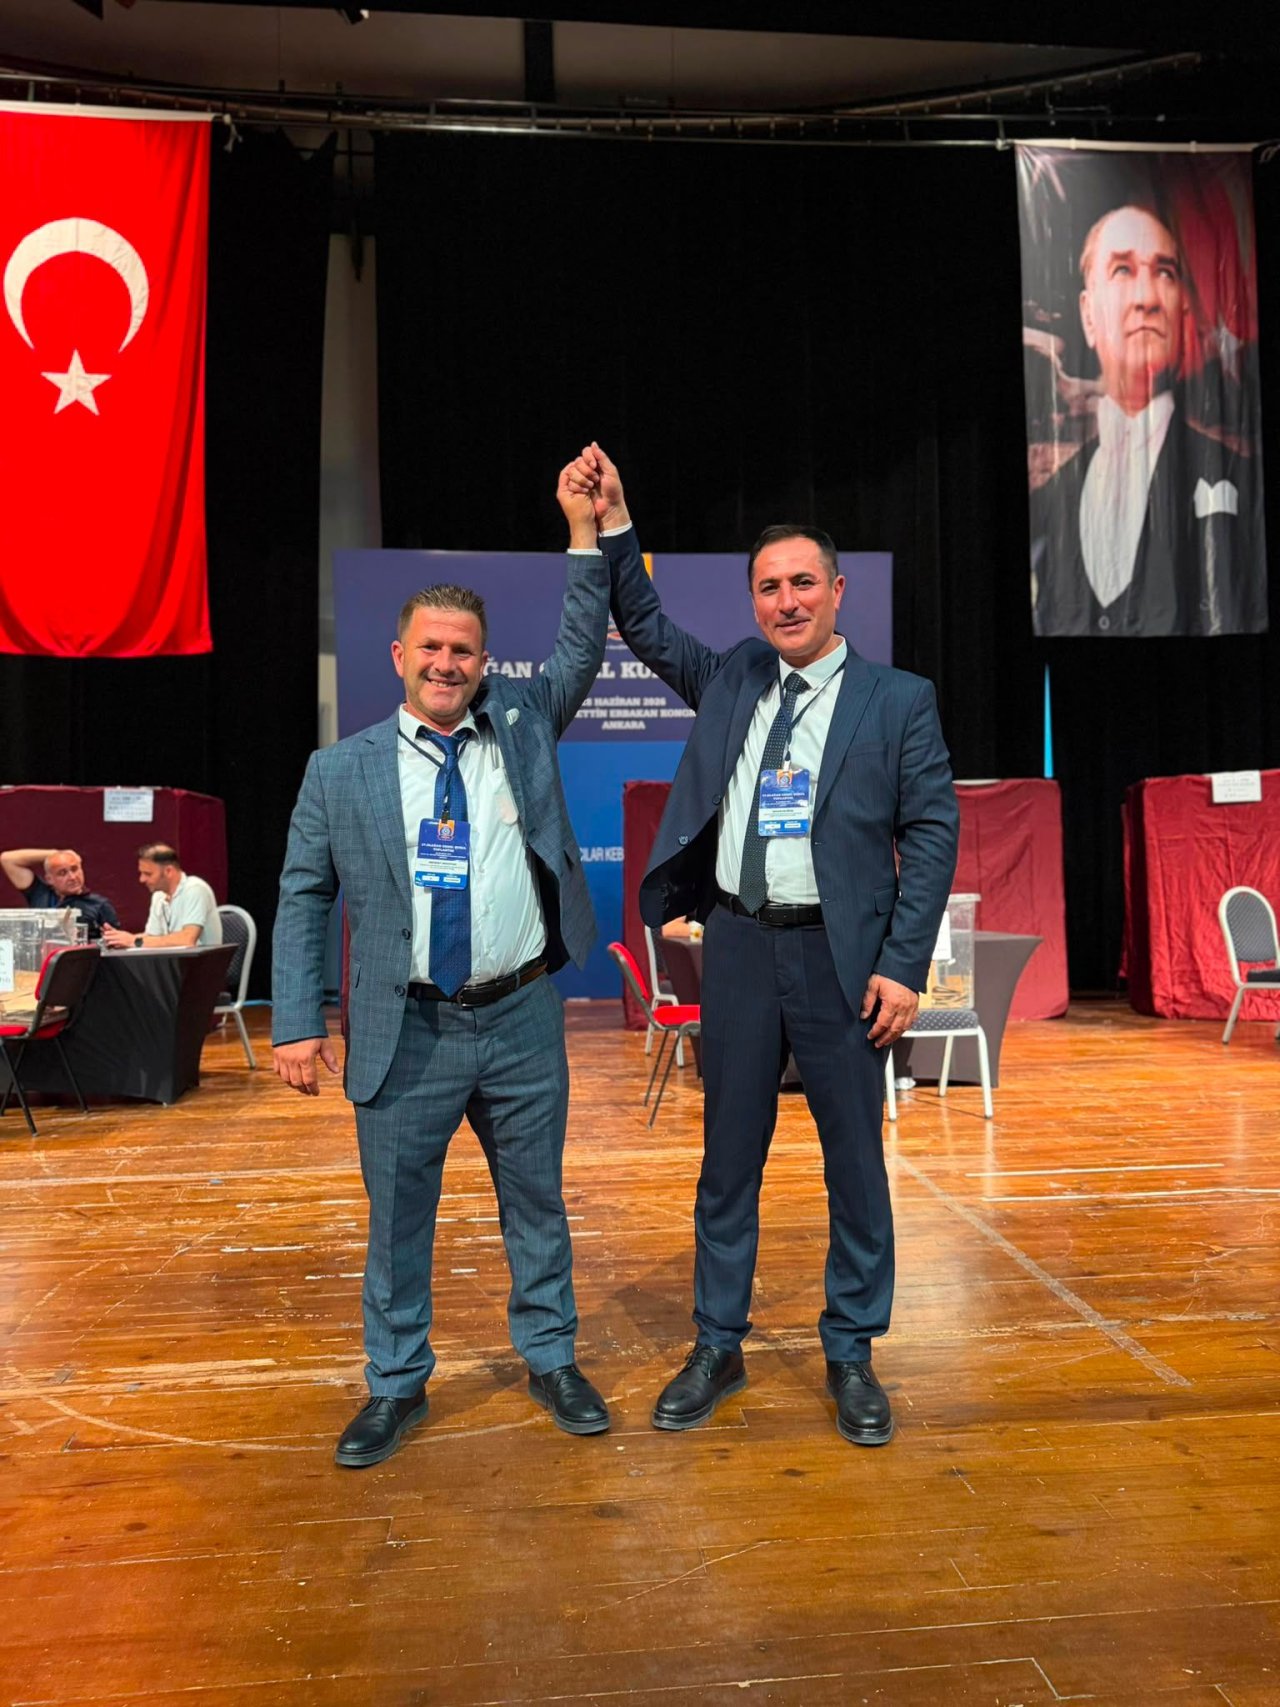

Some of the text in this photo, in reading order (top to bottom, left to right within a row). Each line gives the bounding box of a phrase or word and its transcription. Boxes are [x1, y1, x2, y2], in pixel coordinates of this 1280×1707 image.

[483, 656, 532, 678] ĞAN
[620, 661, 659, 679] KU
[594, 695, 640, 707] HAZİRAN
[575, 707, 608, 718] ETTİN
[609, 708, 658, 718] ERBAKAN
[602, 721, 646, 730] ANKARA
